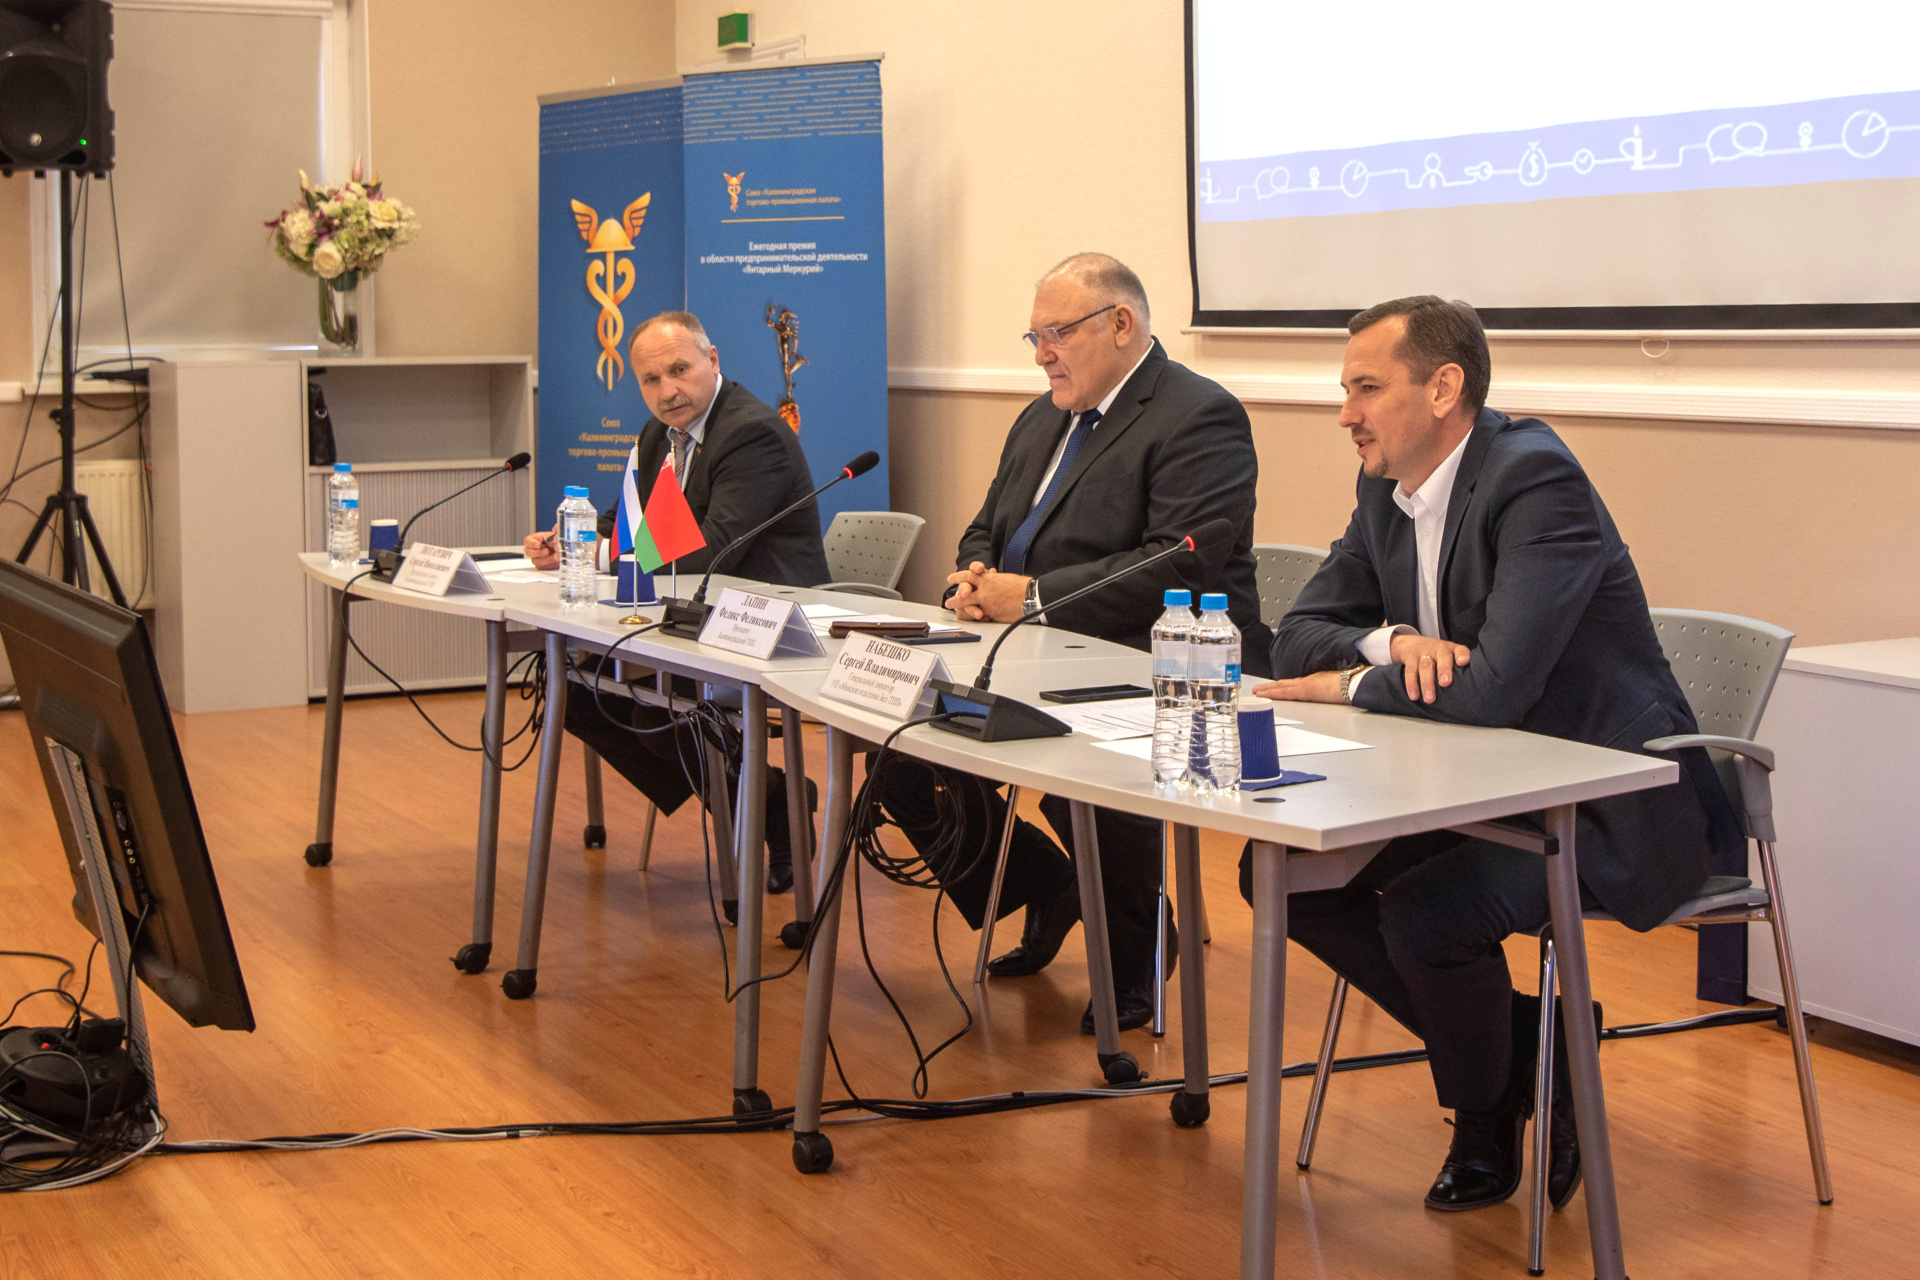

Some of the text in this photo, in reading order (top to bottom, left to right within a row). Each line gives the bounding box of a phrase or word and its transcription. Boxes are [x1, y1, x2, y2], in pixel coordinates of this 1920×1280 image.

[749, 241, 816, 252] Ежегодная премия
[707, 254, 734, 263] области
[735, 252, 816, 264] предпринимательской
[817, 253, 868, 263] деятельности
[743, 264, 824, 276] «Янтарный Меркурий»
[579, 432, 640, 444] «Калининградск
[568, 448, 631, 459] торгово-промыш
[741, 595, 770, 610] ЛАПИН
[719, 606, 778, 630] Феликс Феликсович
[865, 640, 911, 662] НАБЕШКО
[839, 652, 920, 686] Сергей Владимирович
